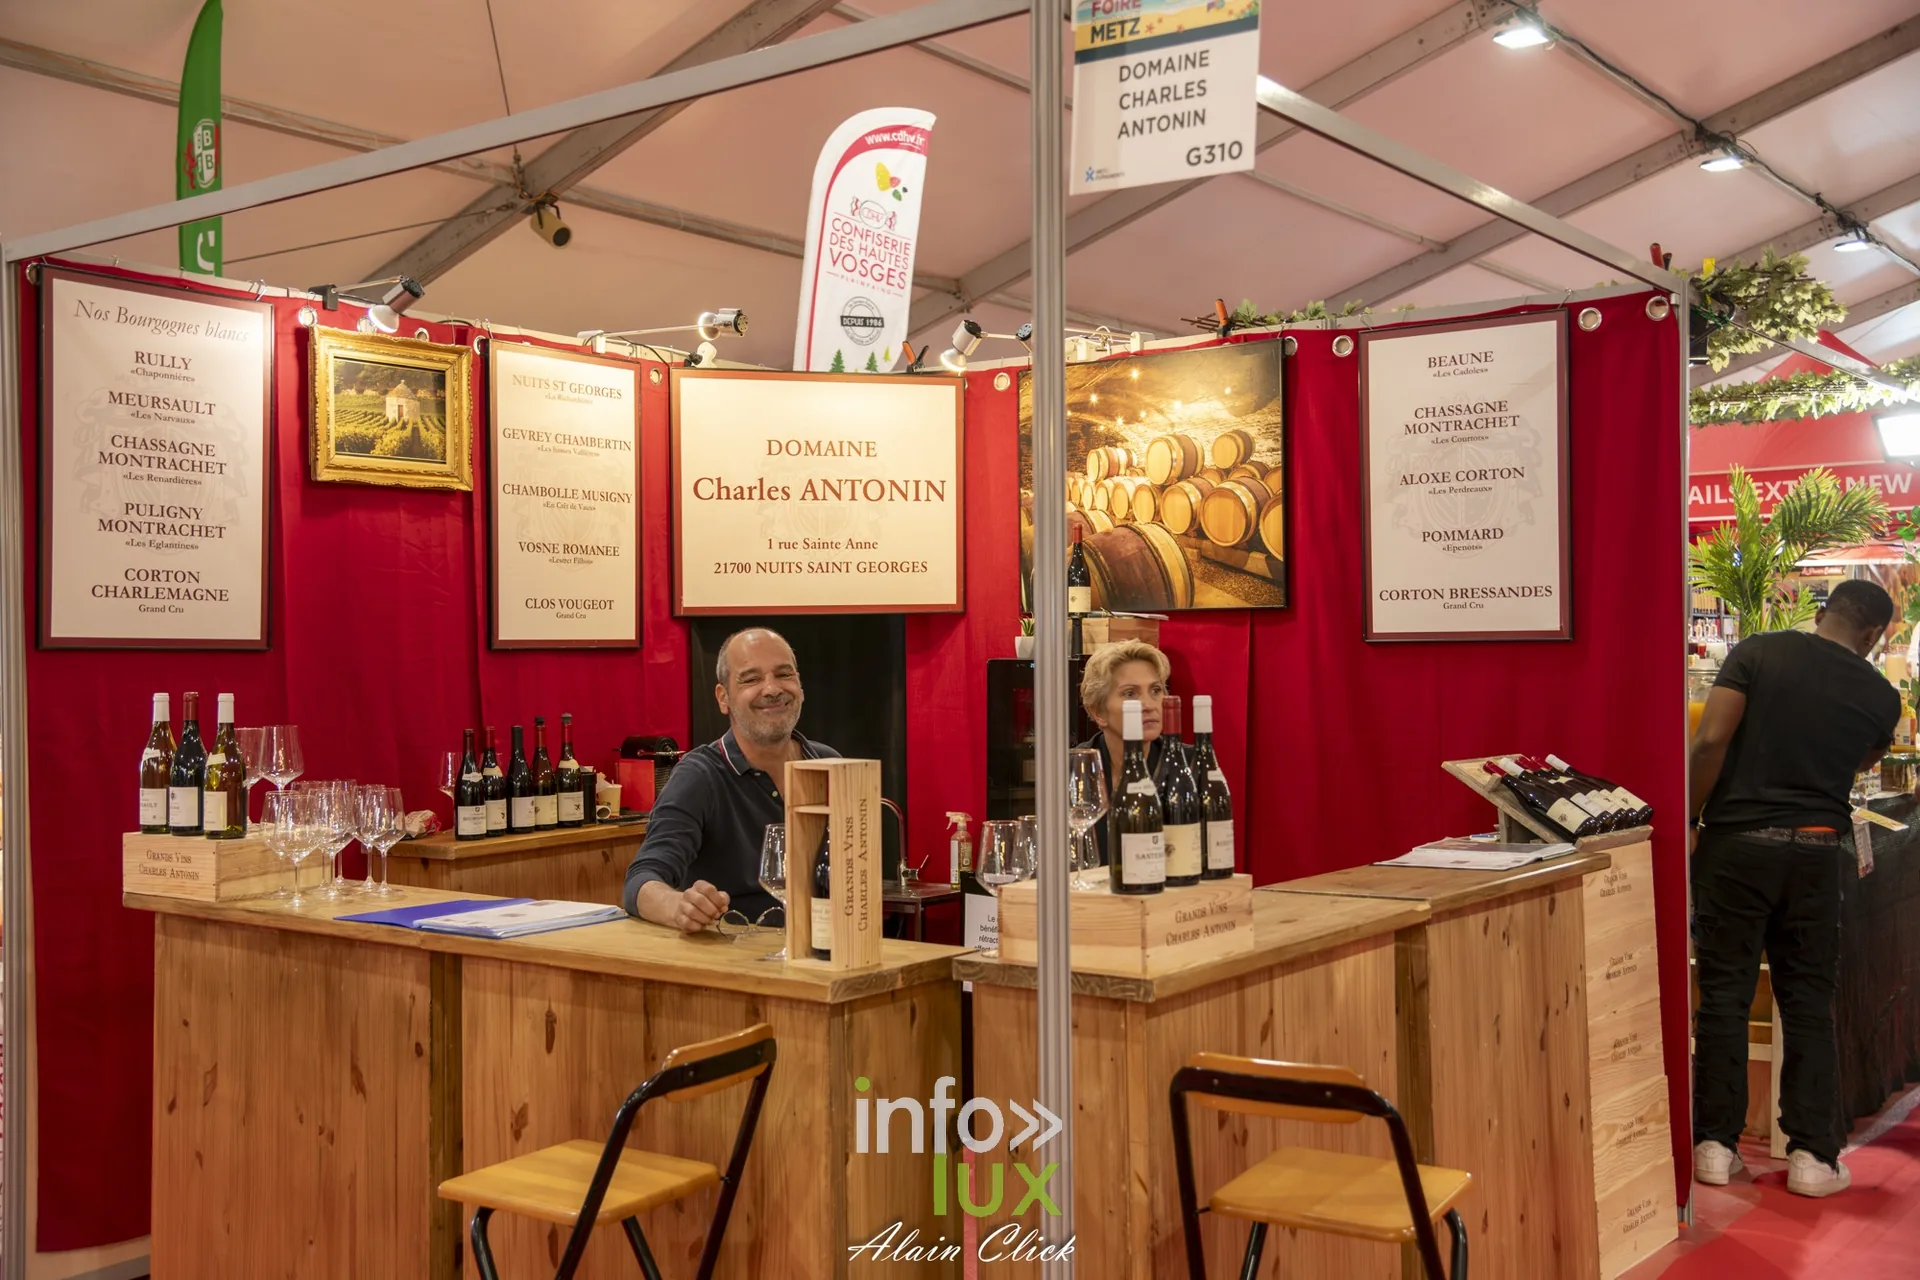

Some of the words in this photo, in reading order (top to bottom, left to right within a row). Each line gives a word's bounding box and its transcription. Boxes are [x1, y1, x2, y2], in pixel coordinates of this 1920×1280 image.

[1090, 17, 1141, 44] METZ
[1119, 50, 1211, 83] DOMAINE
[1118, 79, 1207, 111] CHARLES
[1117, 108, 1206, 140] ANTONIN
[1186, 140, 1243, 167] G310
[831, 217, 911, 257] CONFISERIE
[829, 232, 854, 252] DES
[858, 243, 909, 271] HAUTES
[829, 247, 908, 290] VOSGES
[74, 299, 110, 322] Nos
[116, 305, 200, 337] Bourgognes
[205, 320, 249, 343] blancs
[134, 350, 192, 371] RULLY
[1428, 350, 1494, 369] BEAUNE
[512, 373, 550, 390] NUITS
[552, 379, 566, 392] ST
[569, 382, 622, 400] GEORGES
[108, 390, 216, 416] MEURSAULT
[1414, 400, 1509, 420] CHASSAGNE
[1404, 415, 1520, 436] MONTRACHET
[111, 434, 216, 458] CHASSAGNE
[502, 427, 552, 443] GEVREY
[554, 432, 632, 451] CHAMBERTIN
[766, 439, 877, 458] DOMAINE
[98, 452, 227, 475] MONTRACHET
[1400, 471, 1451, 486] ALOXE
[1455, 466, 1525, 483] CORTON
[502, 483, 579, 500] CHAMBOLLE
[582, 489, 633, 504] MUSIGNY
[693, 476, 791, 501] Charles
[799, 478, 947, 502] ANTONIN
[124, 502, 203, 521] PULIGNY
[97, 518, 226, 539] MONTRACHET
[1422, 527, 1504, 543] POMMARD
[518, 541, 559, 555] VOSNE
[563, 543, 620, 557] ROMANEE
[767, 538, 773, 550] 1
[778, 540, 799, 550] rue
[802, 537, 841, 550] Sainte
[845, 538, 879, 550] Anne
[124, 568, 201, 584] CORTON
[714, 562, 752, 574] 21700
[755, 561, 803, 574] NUITS
[806, 561, 853, 574] SAINT
[856, 560, 928, 574] GEORGES
[91, 584, 229, 602] CHARLEMAGNE
[1379, 588, 1445, 602] CORTON
[1449, 585, 1553, 600] BRESSANDES
[138, 604, 166, 614] Grand
[168, 604, 184, 614] Cru
[525, 597, 556, 610] CLOS
[558, 598, 614, 611] VOUGEOT
[1443, 602, 1467, 610] Grand
[1469, 601, 1484, 610] Cru
[556, 612, 574, 620] Grand
[575, 612, 586, 620] Cru
[987, 914, 996, 922] Le
